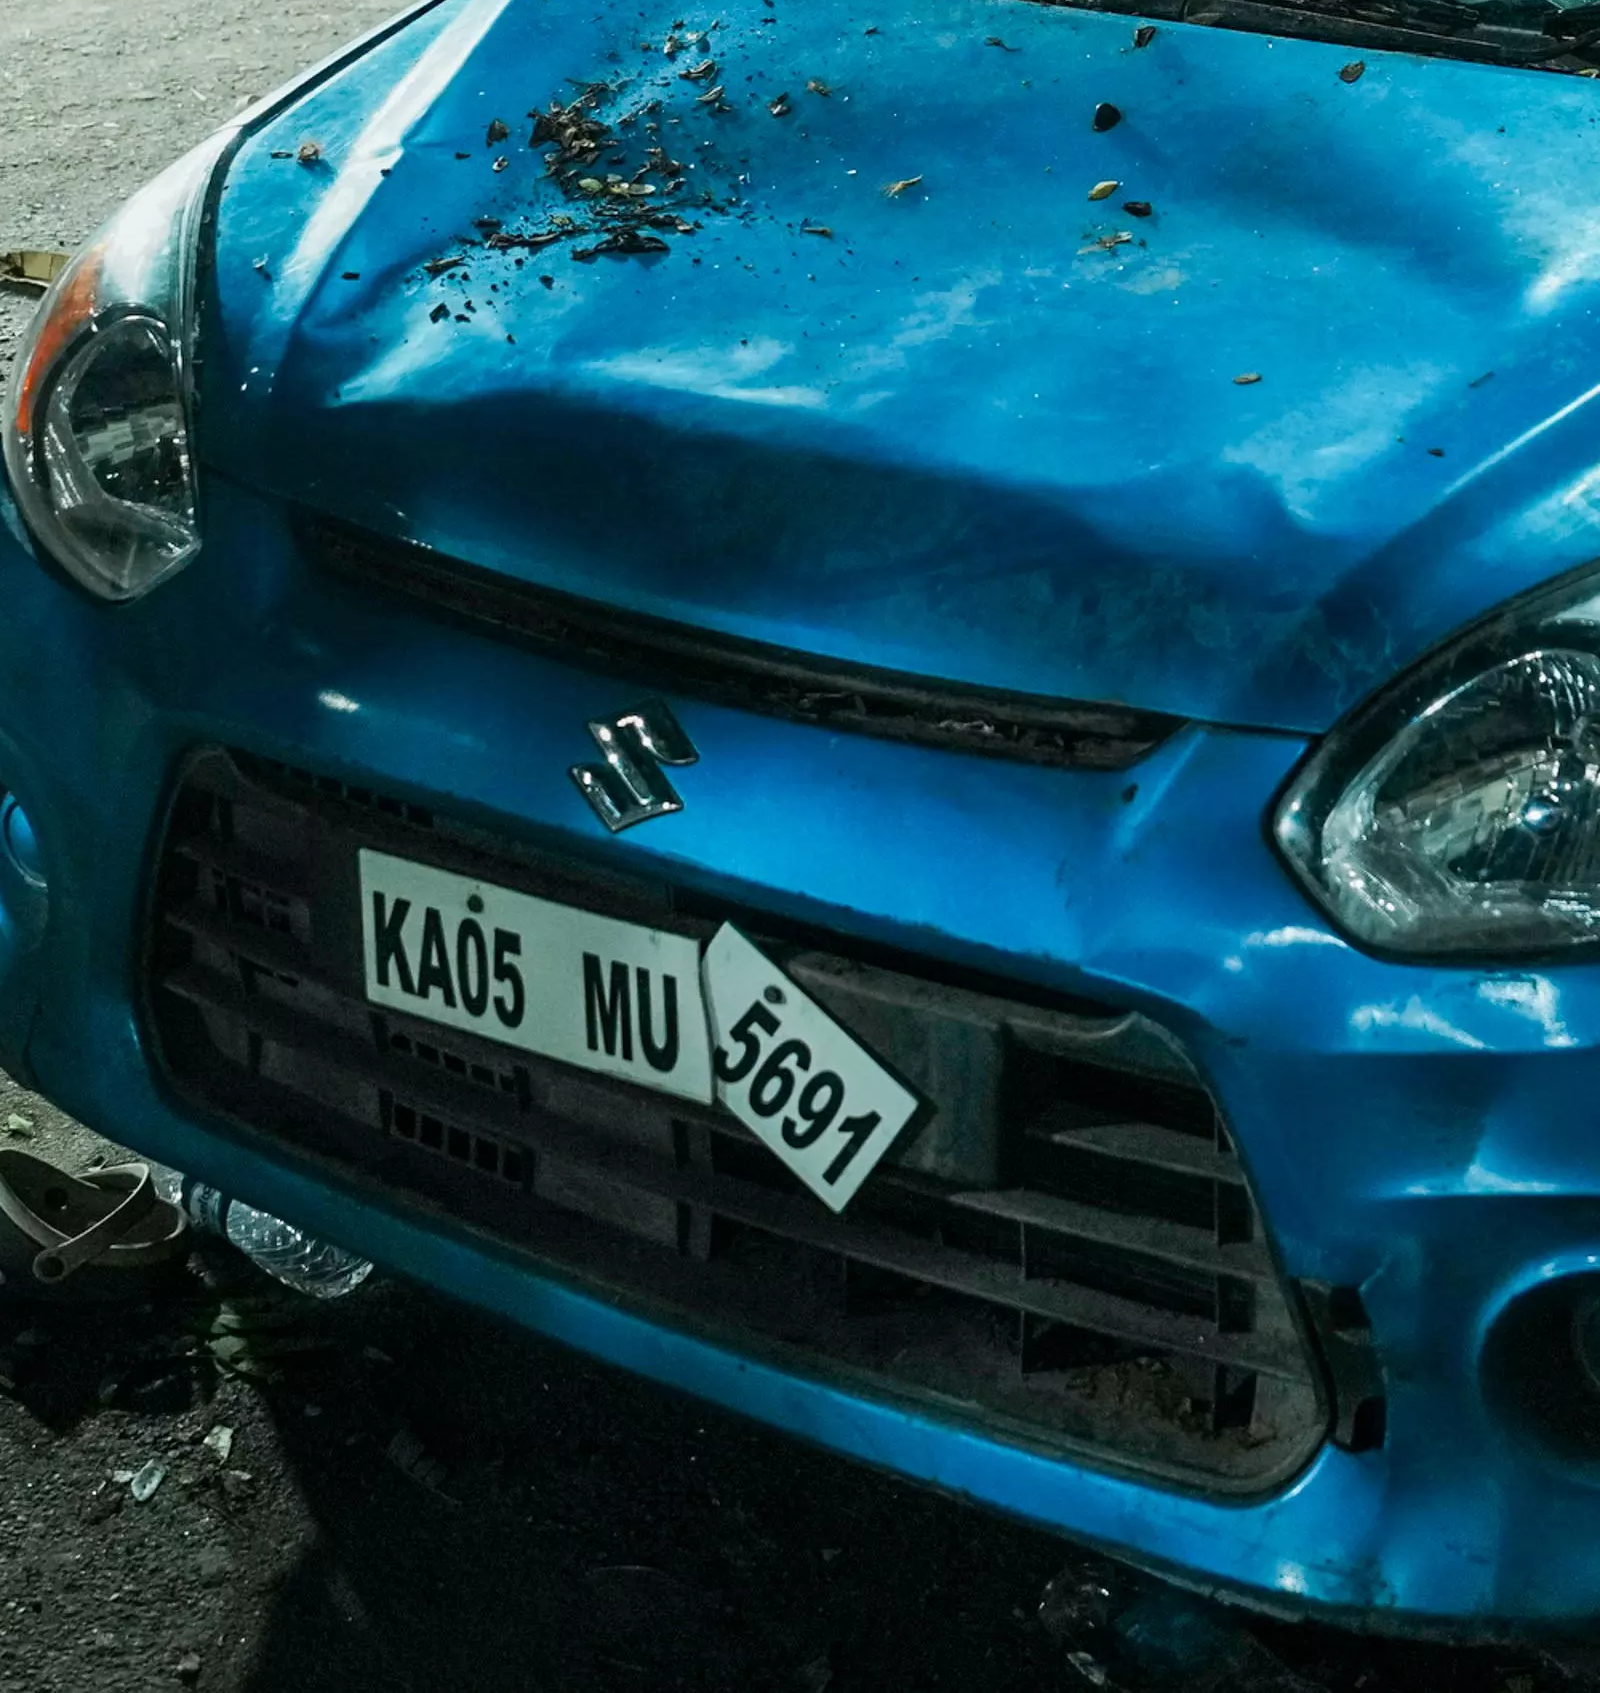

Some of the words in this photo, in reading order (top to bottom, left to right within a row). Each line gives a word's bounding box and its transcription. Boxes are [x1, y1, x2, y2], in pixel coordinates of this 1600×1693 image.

[372, 891, 526, 1028] KA05
[582, 952, 679, 1072] MU
[713, 1000, 883, 1186] 5691
